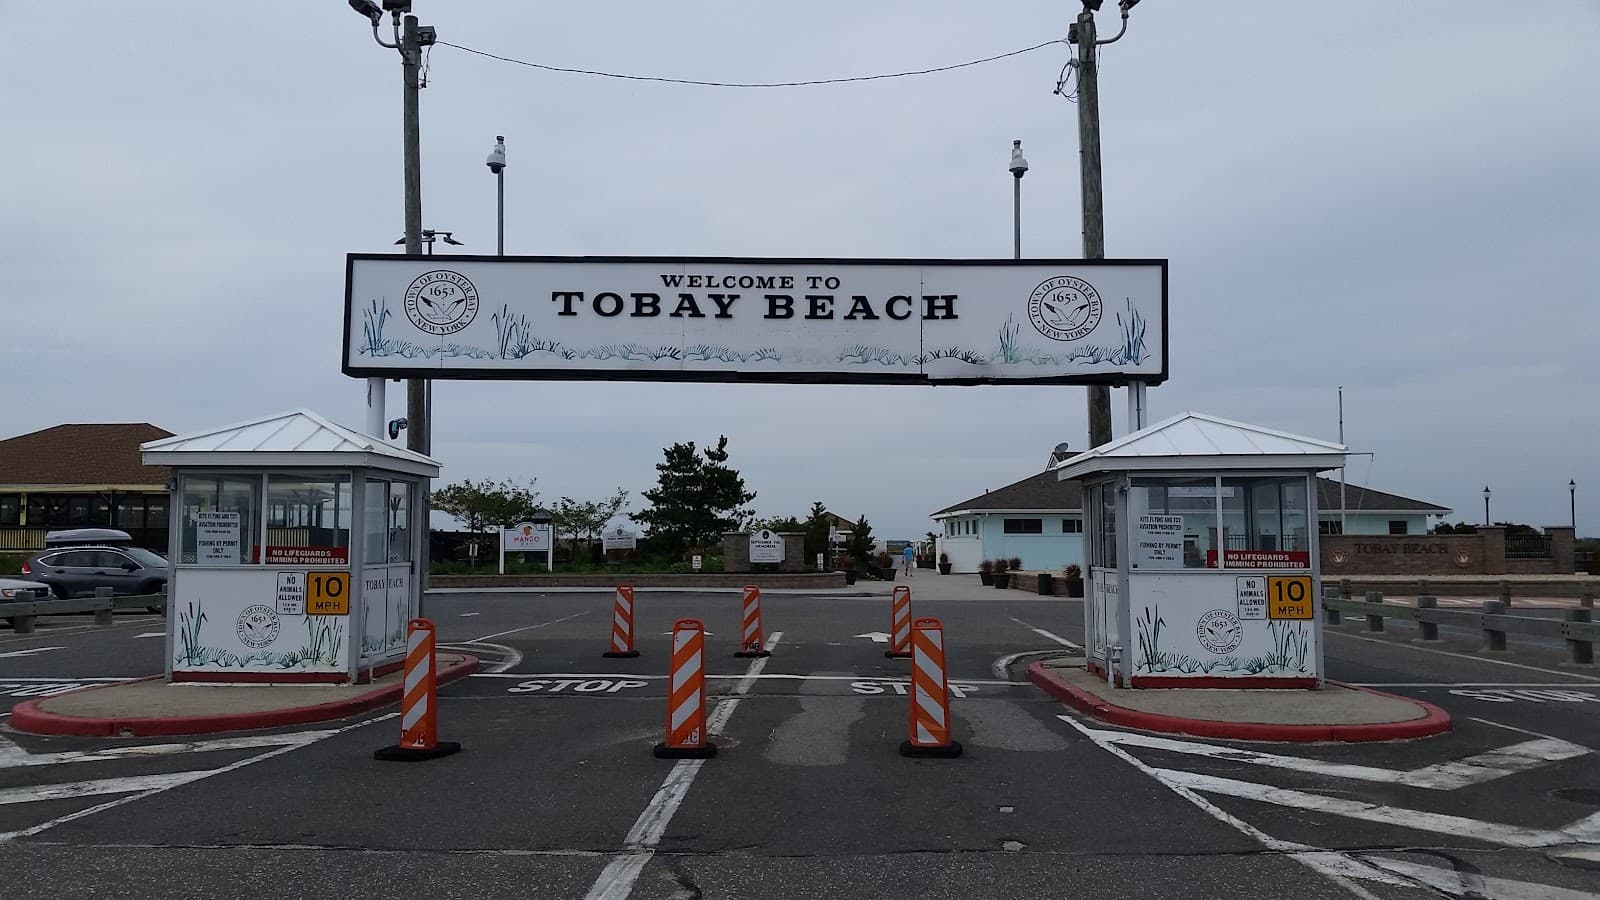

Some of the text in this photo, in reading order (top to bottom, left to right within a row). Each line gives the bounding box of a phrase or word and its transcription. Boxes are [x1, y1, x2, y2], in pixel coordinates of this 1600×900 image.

[661, 274, 841, 290] WELCOME TO
[407, 272, 476, 313] TOWN OF OYSTER BAY
[429, 285, 455, 299] 1653
[1031, 279, 1099, 319] TOWN OF OYSTER BAY
[1052, 291, 1078, 305] 1653
[552, 291, 959, 320] TOBAY BEACH
[415, 318, 467, 332] NEW YORK
[1040, 324, 1091, 338] NEW YORK
[1354, 544, 1448, 554] TOBAY BEACH
[286, 576, 295, 584] NO
[315, 576, 342, 598] 10
[366, 578, 404, 590] TOBAY EACH
[1246, 580, 1256, 588] NO
[1276, 581, 1305, 602] 10
[315, 602, 340, 610] MPH
[1278, 606, 1304, 614] MPH
[507, 680, 649, 693] STOP
[850, 682, 979, 698] STP
